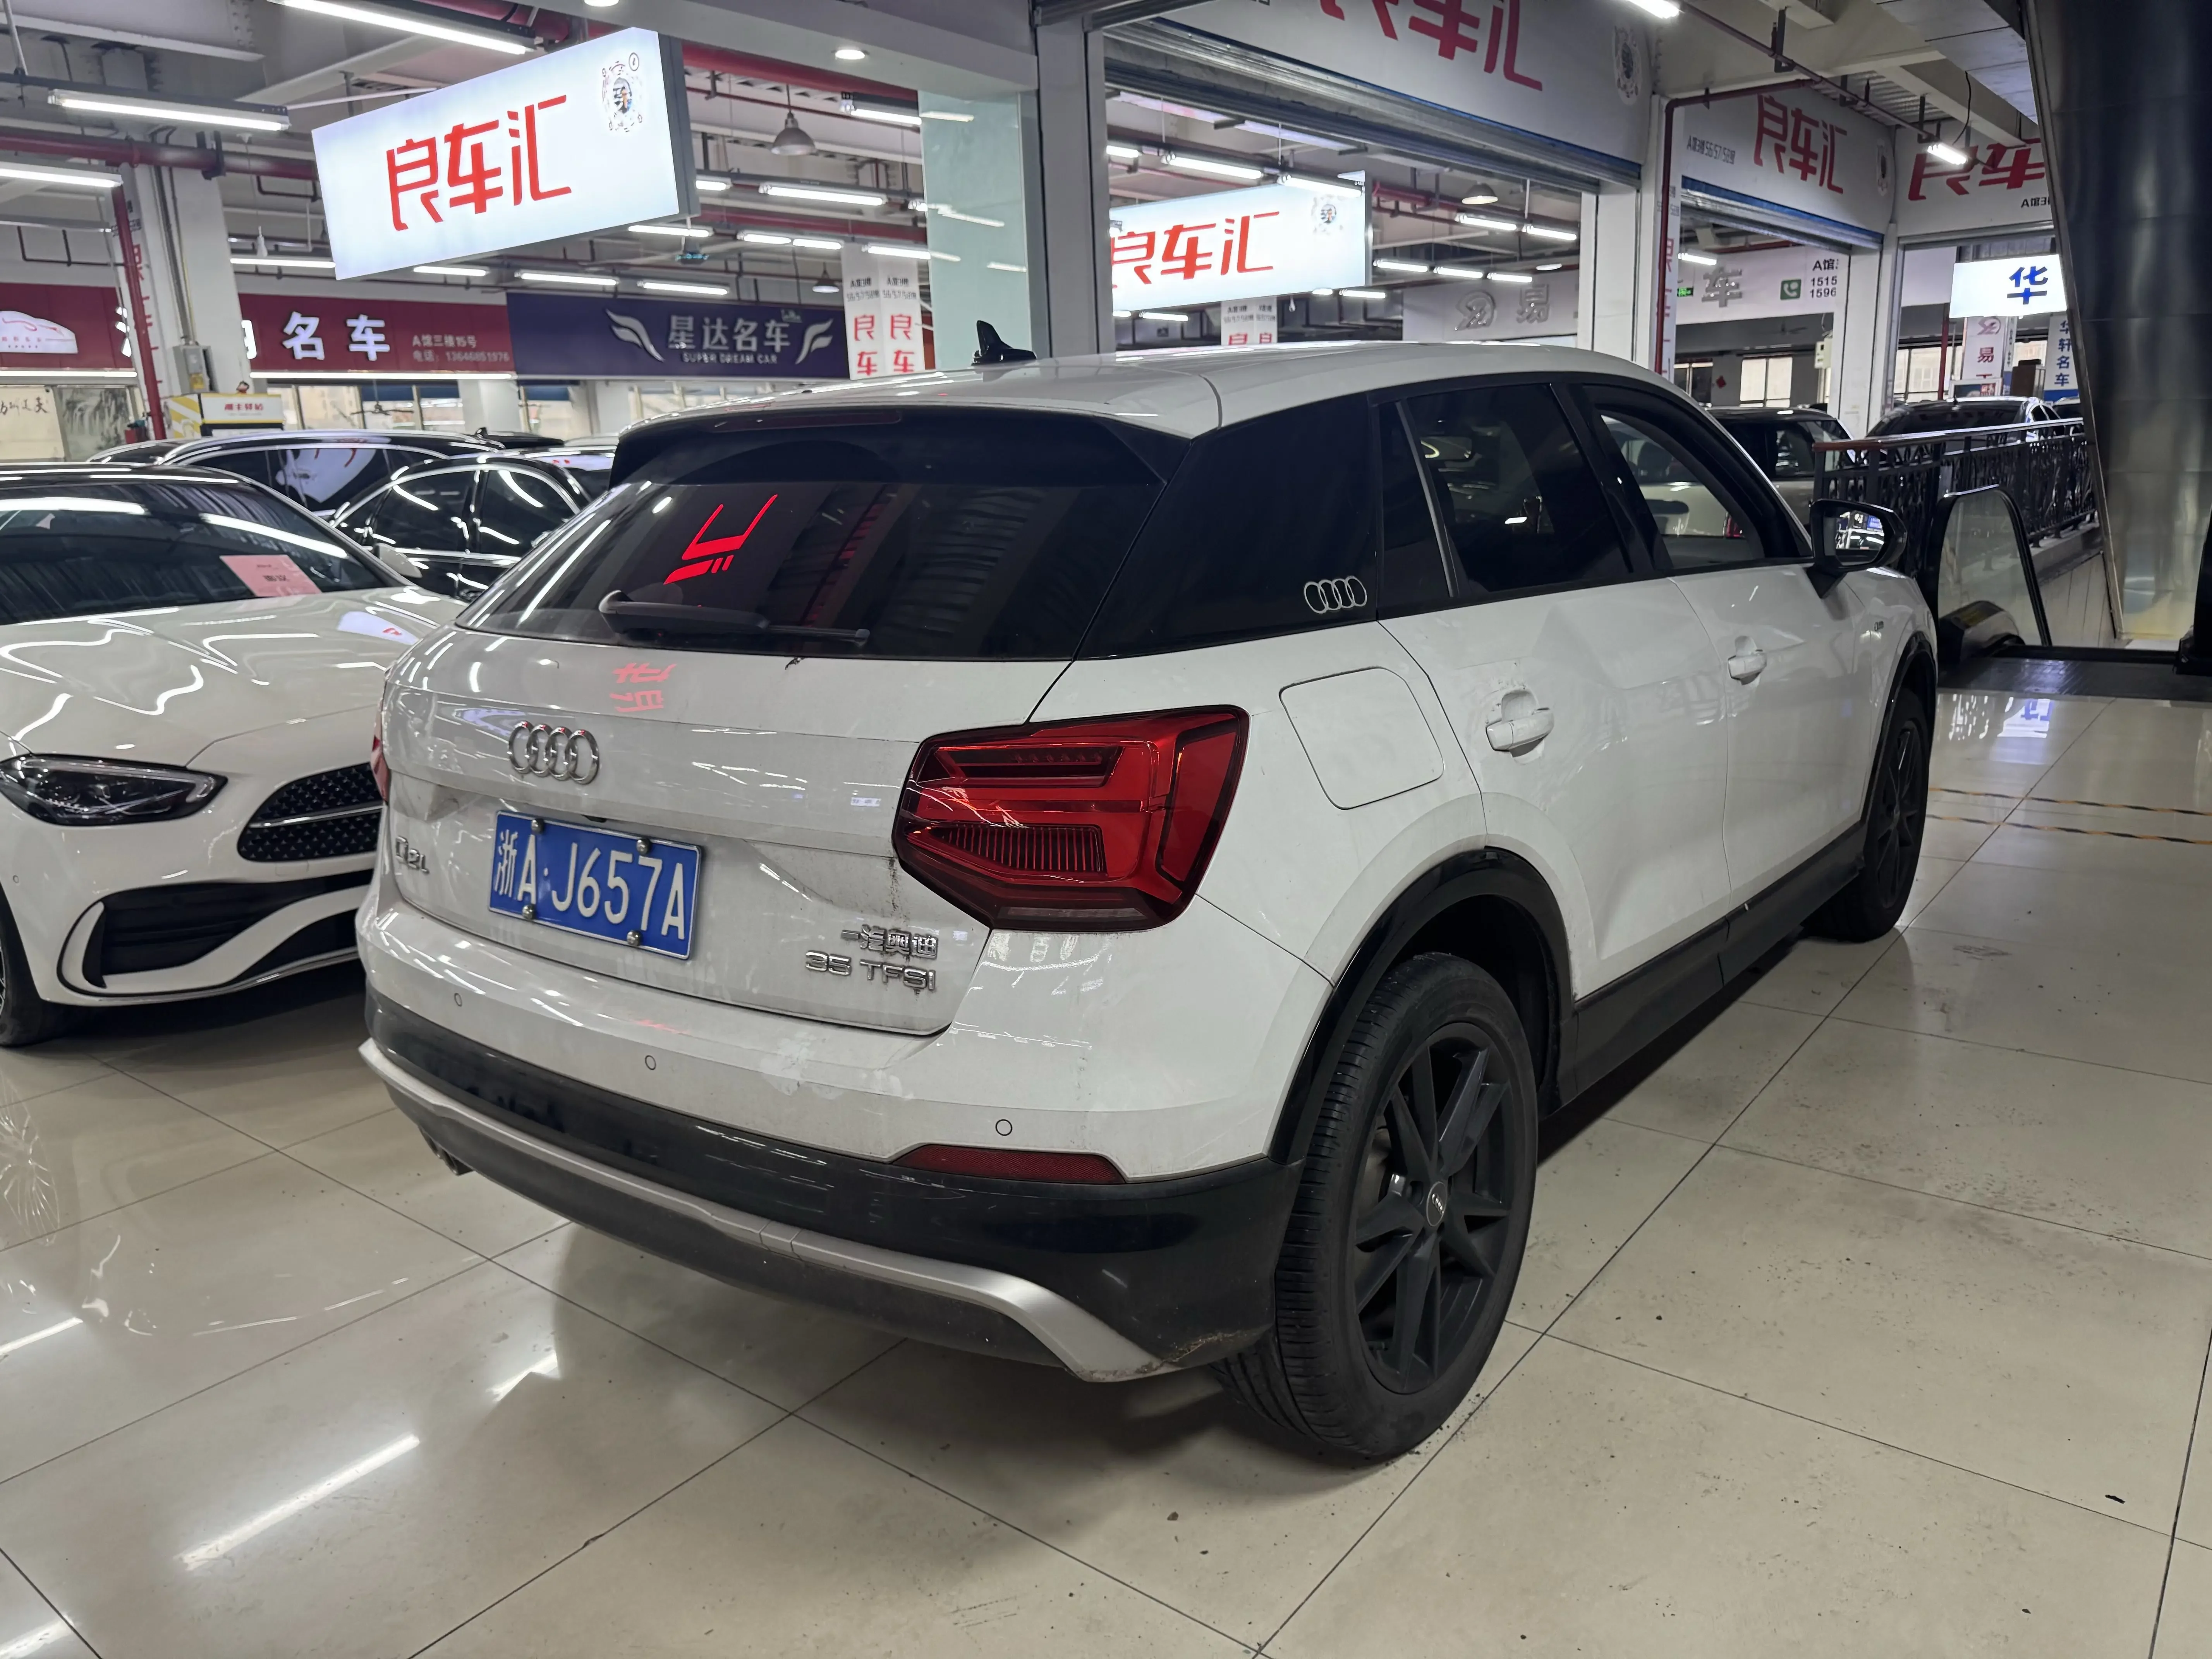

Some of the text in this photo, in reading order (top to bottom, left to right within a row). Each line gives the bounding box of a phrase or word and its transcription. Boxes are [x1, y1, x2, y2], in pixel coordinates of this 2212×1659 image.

[386, 95, 571, 231] 良车汇
[1754, 94, 1847, 194] 良车汇
[2021, 197, 2051, 208] A馆3
[1111, 211, 1280, 289] 良车汇
[1702, 267, 1743, 307] 车
[1811, 275, 1837, 287] 1515
[2007, 266, 2048, 304] 华
[668, 315, 790, 352] 星达名车
[682, 352, 716, 363] SUPER
[757, 353, 777, 364] CAR
[2054, 320, 2071, 386] 华轩名车
[395, 837, 429, 873] Q2L
[841, 924, 938, 959] 一汽奥迪
[805, 950, 936, 990] 35 TFSI
